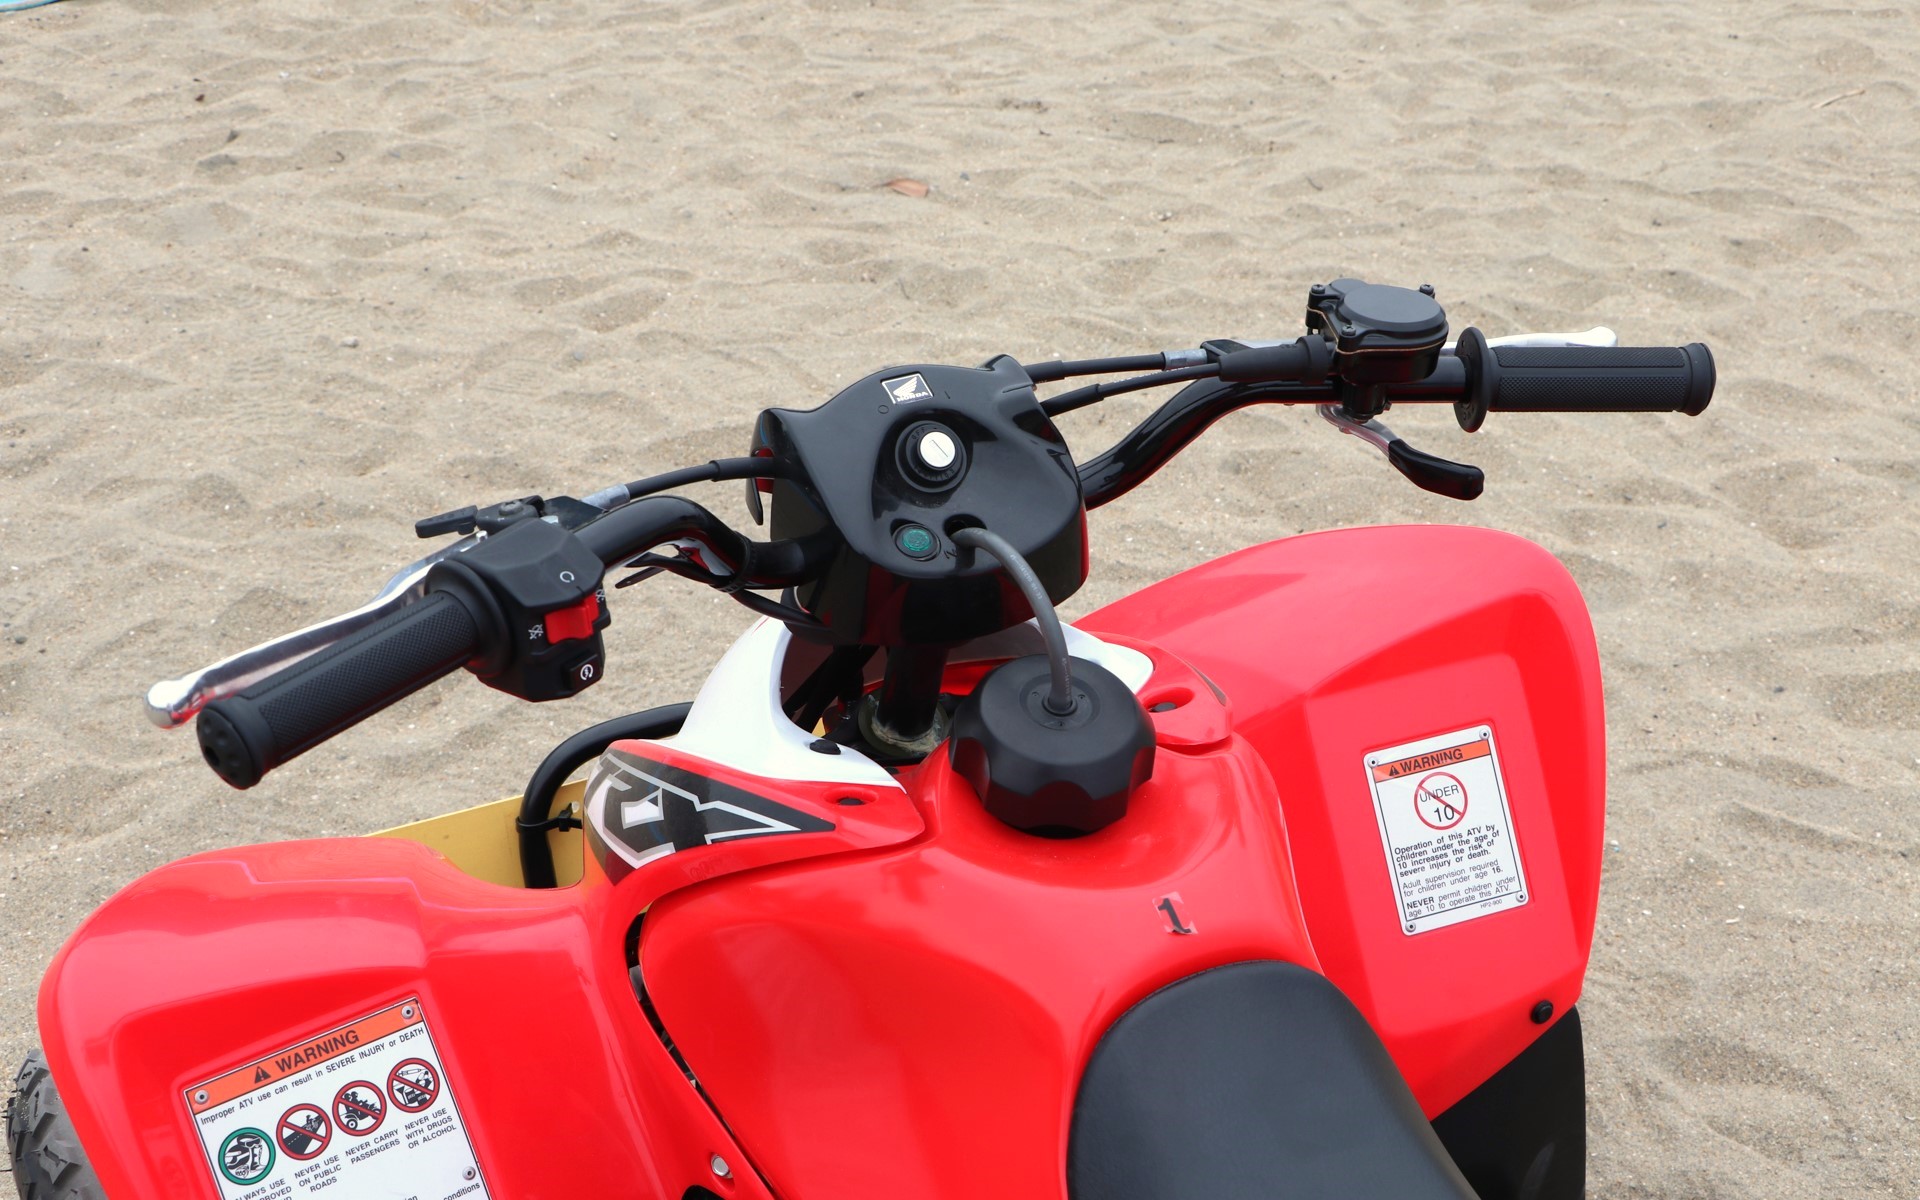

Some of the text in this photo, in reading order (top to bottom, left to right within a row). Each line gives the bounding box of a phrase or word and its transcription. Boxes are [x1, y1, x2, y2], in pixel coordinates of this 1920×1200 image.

[1400, 749, 1463, 772] WARNING
[1420, 784, 1459, 802] UNDER
[1434, 804, 1454, 822] 10
[1394, 824, 1495, 855] Operation of this ATV by
[1396, 830, 1499, 862] children under the age of
[1411, 852, 1448, 866] increases
[1452, 848, 1464, 856] the
[1468, 843, 1482, 851] risk
[1487, 839, 1494, 847] of
[1400, 866, 1425, 877] severe
[1430, 860, 1450, 870] injury
[1468, 849, 1490, 860] death.
[1403, 859, 1498, 890] Adult supervision required
[1406, 876, 1516, 910] NEVER permit children under
[1418, 882, 1446, 894] children
[1450, 875, 1470, 886] under
[1474, 870, 1488, 879] age
[1492, 866, 1503, 874] 16.
[1158, 898, 1192, 933] 1
[1409, 910, 1422, 918] age
[1426, 904, 1434, 912] 10
[1449, 895, 1476, 907] operate
[1479, 890, 1492, 898] this
[275, 1030, 359, 1072] WARNING
[200, 1106, 235, 1125] Improper
[239, 1097, 254, 1110] ATV
[257, 1092, 271, 1102] use
[275, 1084, 288, 1094] can
[292, 1073, 312, 1087] result
[326, 1055, 356, 1073] SEVERE
[359, 1043, 385, 1059] INJURY
[399, 1027, 424, 1043] DEATH
[404, 1108, 447, 1130] NEVER USE
[405, 1116, 452, 1140] WITH DRUGS
[345, 1129, 399, 1156] NEVER CARRY
[408, 1124, 456, 1149] OR ALCOHOL
[351, 1139, 400, 1164] PASSENGERS
[294, 1155, 339, 1178] NEVER USE
[299, 1164, 341, 1187] ON PUBLIC
[269, 1178, 286, 1190] USE
[310, 1176, 337, 1192] ROADS
